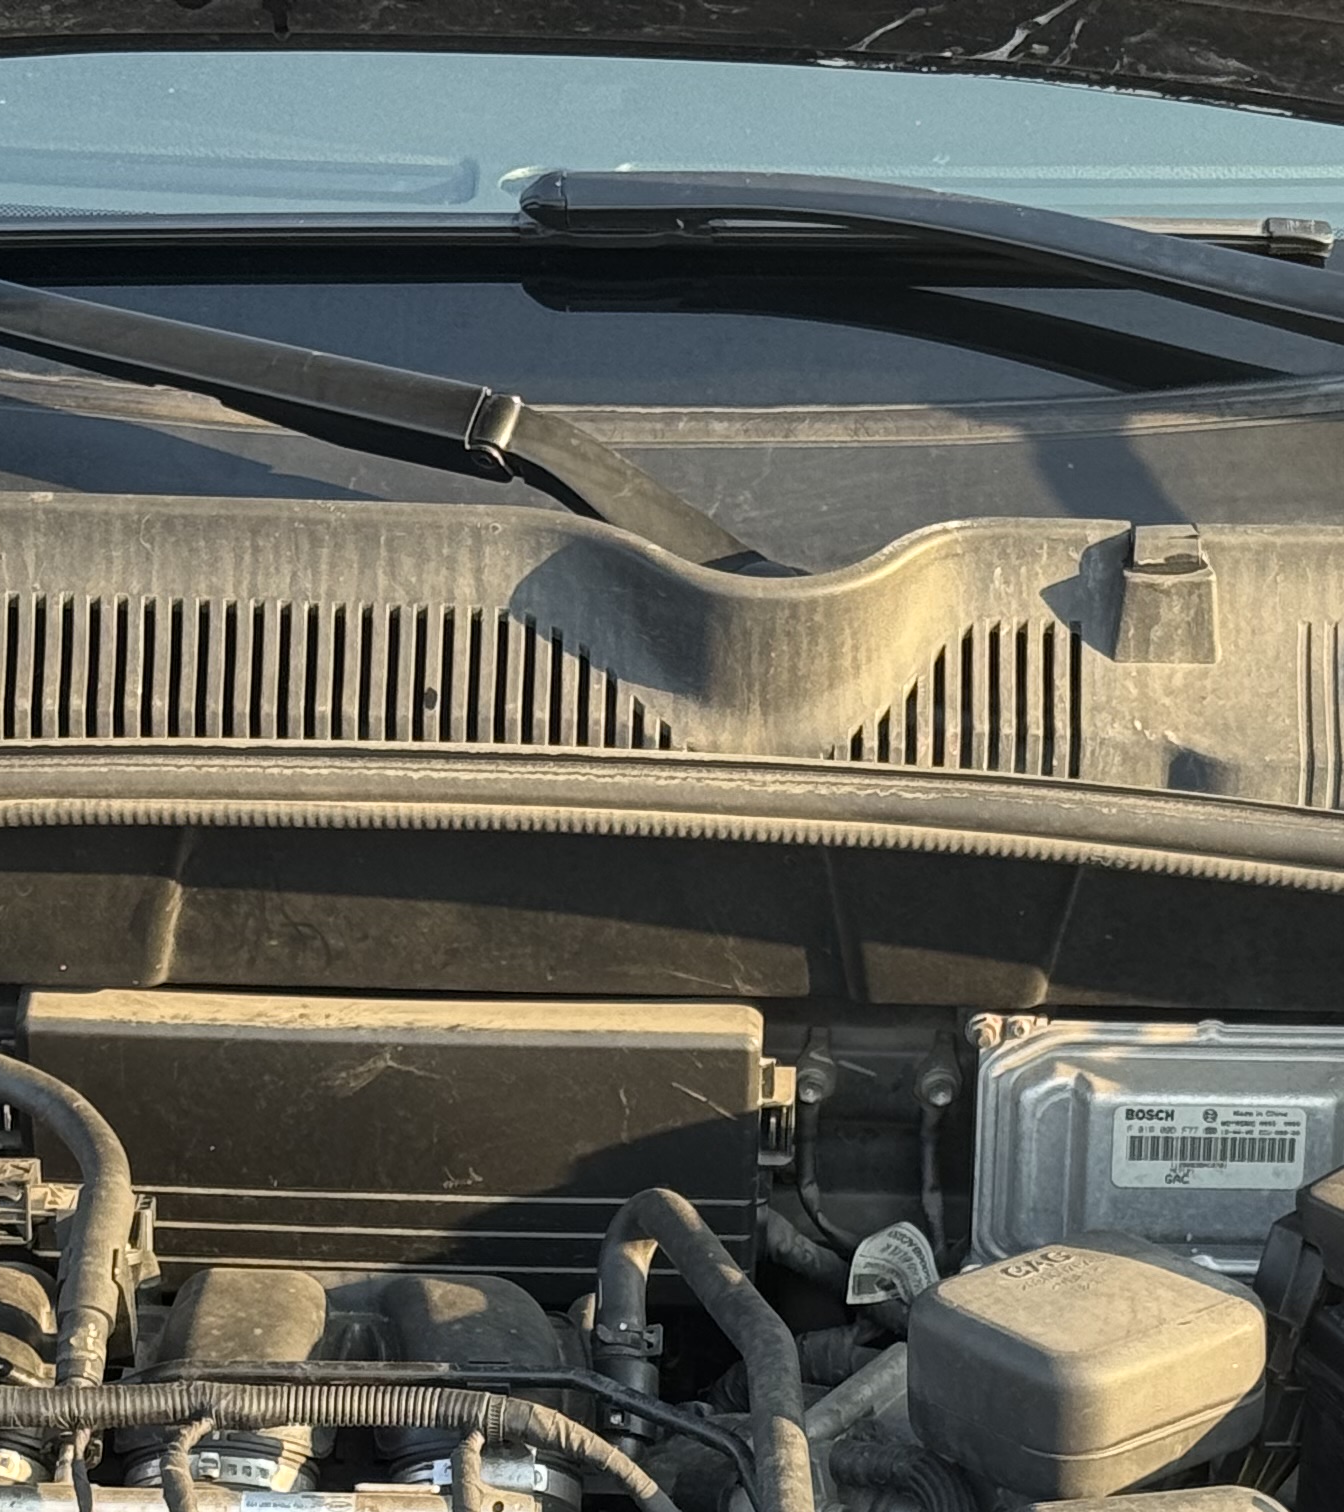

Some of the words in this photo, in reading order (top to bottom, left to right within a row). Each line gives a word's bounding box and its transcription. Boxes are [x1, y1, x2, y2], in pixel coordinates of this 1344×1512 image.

[1125, 1109, 1175, 1122] BOSCH
[1164, 1174, 1191, 1185] GAC
[999, 1250, 1074, 1279] GAC
